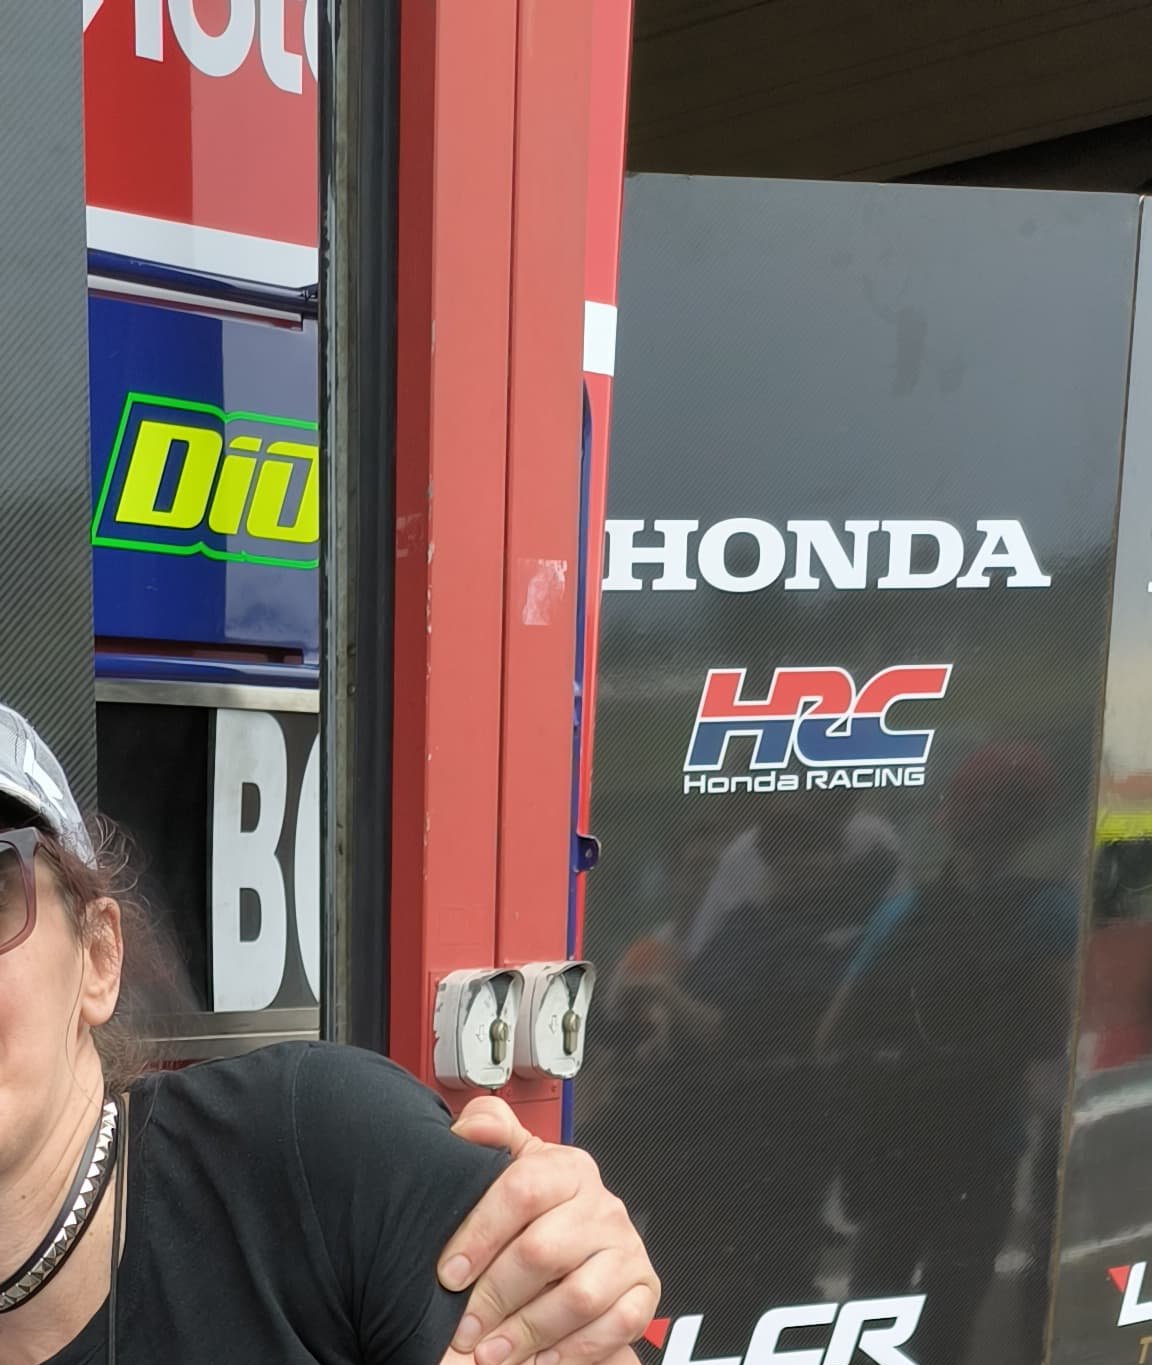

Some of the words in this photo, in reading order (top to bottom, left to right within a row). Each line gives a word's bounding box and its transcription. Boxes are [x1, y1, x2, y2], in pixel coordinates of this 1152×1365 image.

[601, 517, 1052, 593] HONDA
[683, 664, 953, 771] HRC
[683, 769, 799, 795] Honda
[805, 766, 926, 790] RACING
